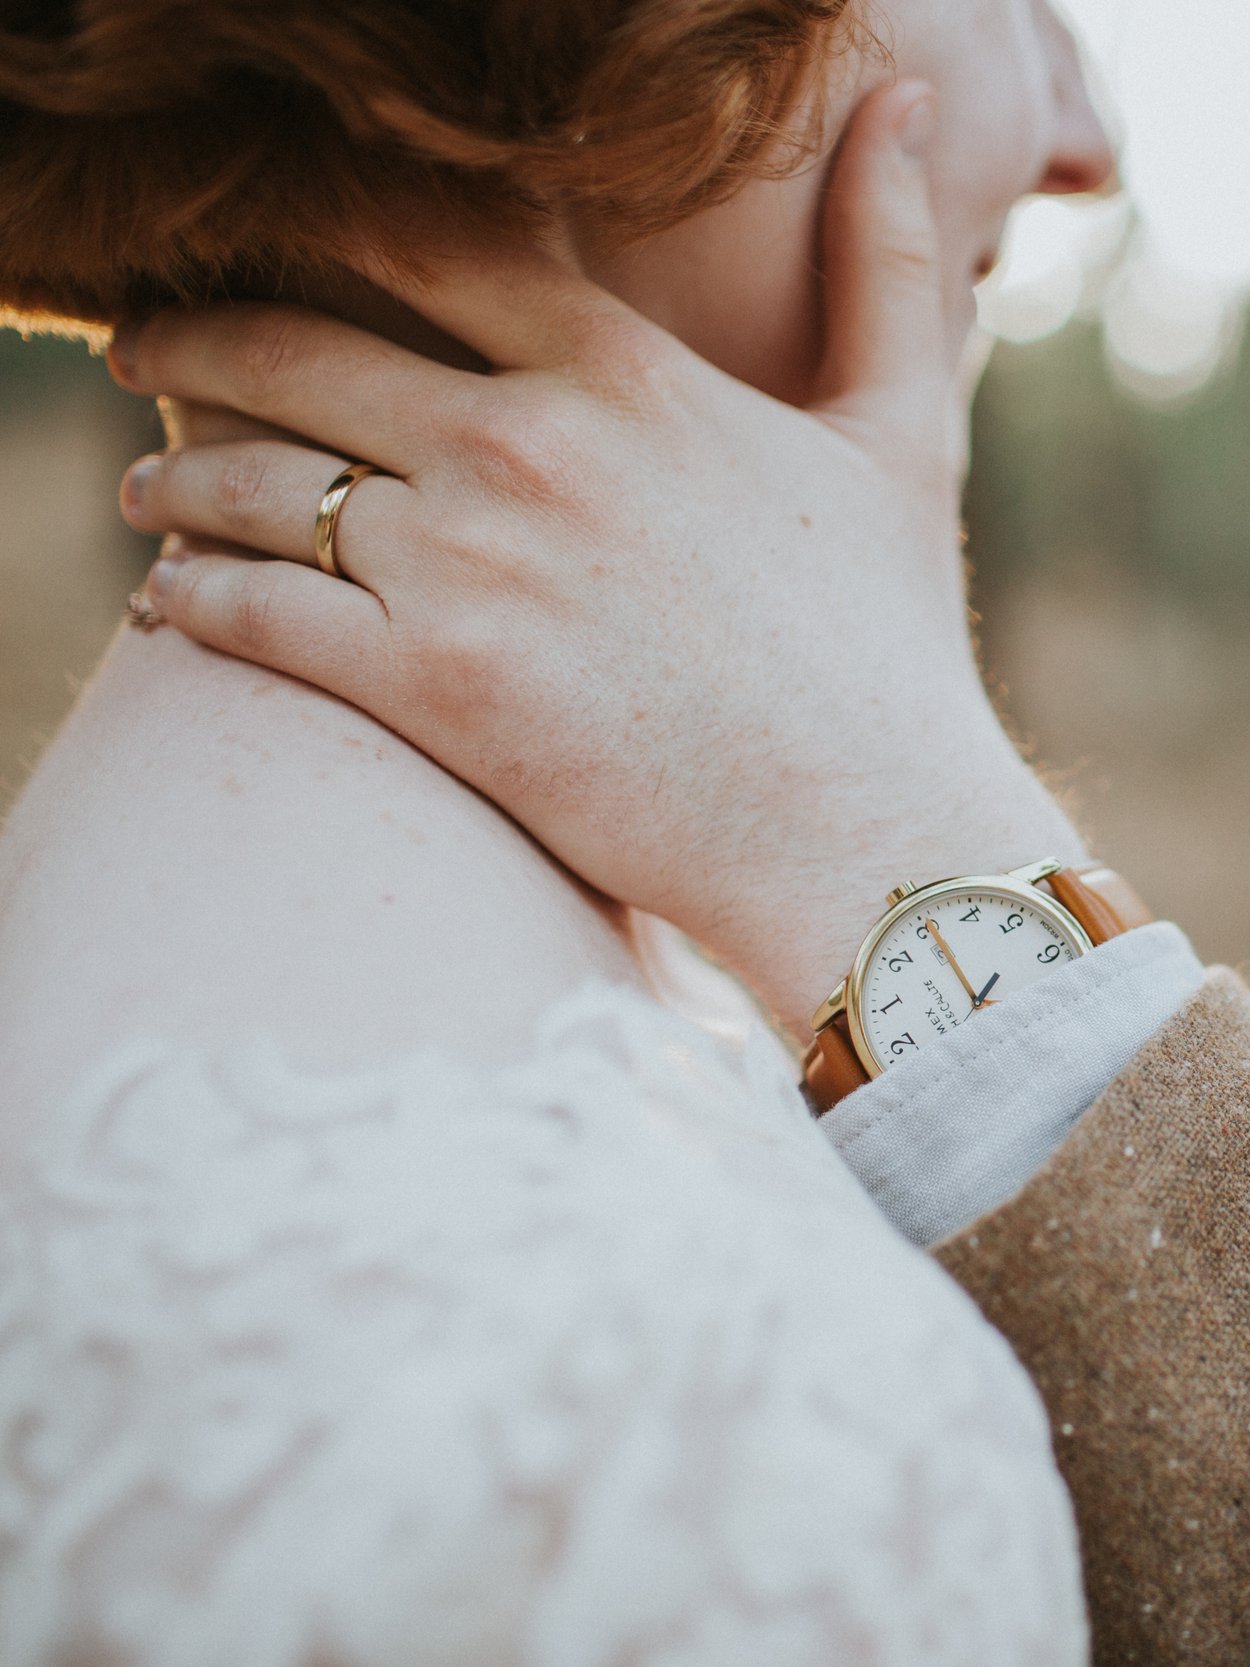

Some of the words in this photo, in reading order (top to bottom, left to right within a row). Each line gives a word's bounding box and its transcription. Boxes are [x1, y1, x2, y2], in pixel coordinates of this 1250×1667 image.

[959, 905, 981, 922] 4
[917, 919, 939, 939] 3
[998, 914, 1023, 934] 5
[889, 950, 914, 972] 2
[1037, 944, 1060, 963] 6
[880, 994, 903, 1014] 1
[891, 1032, 919, 1055] 2
